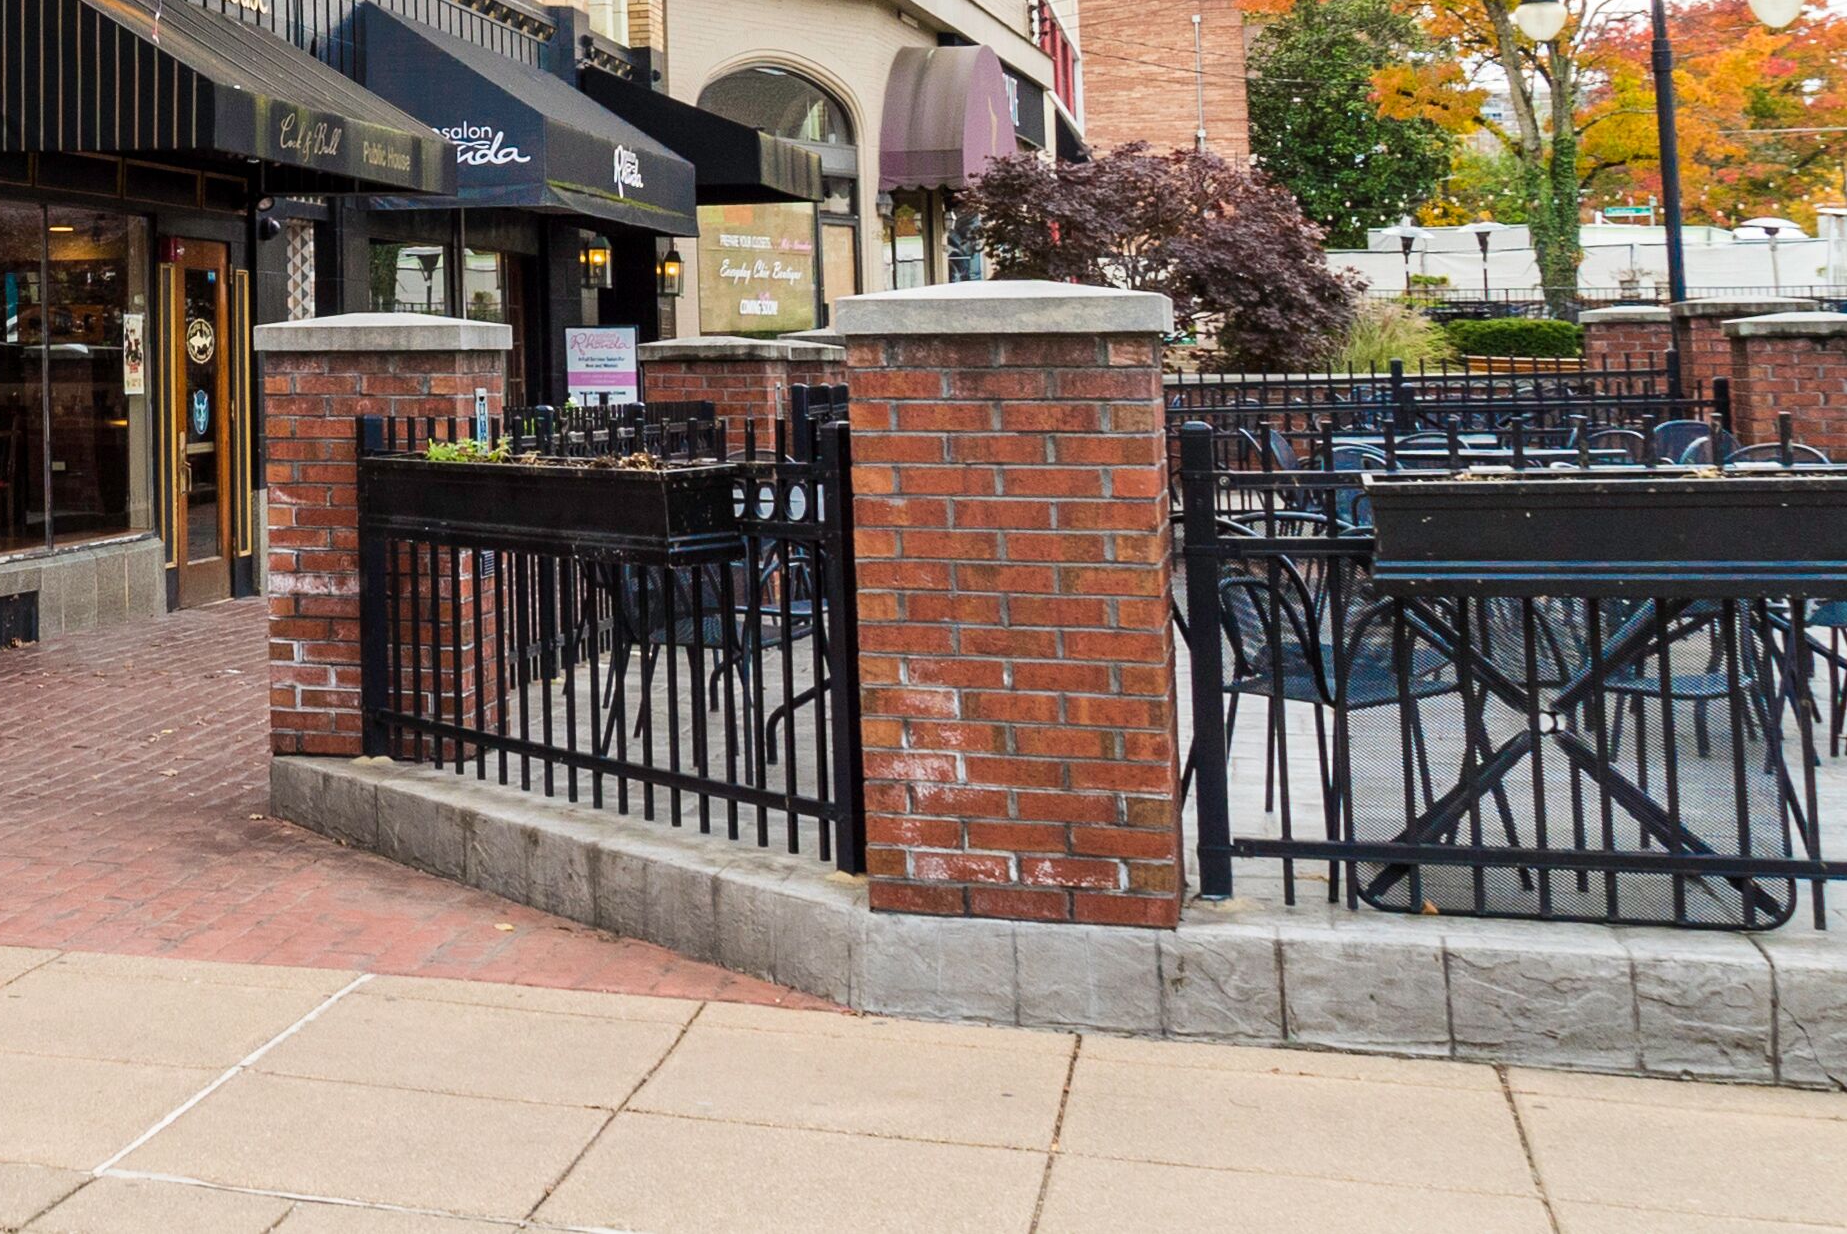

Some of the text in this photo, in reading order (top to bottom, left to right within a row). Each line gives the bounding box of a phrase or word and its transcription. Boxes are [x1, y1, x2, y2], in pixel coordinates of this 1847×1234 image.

[279, 113, 306, 149] Cock
[313, 122, 343, 156] Bull
[443, 120, 493, 139] salon
[363, 141, 411, 171] Public House
[456, 131, 531, 165] nda
[719, 258, 802, 285] Everyday Chic Boutique
[571, 332, 631, 356] Rhonda
